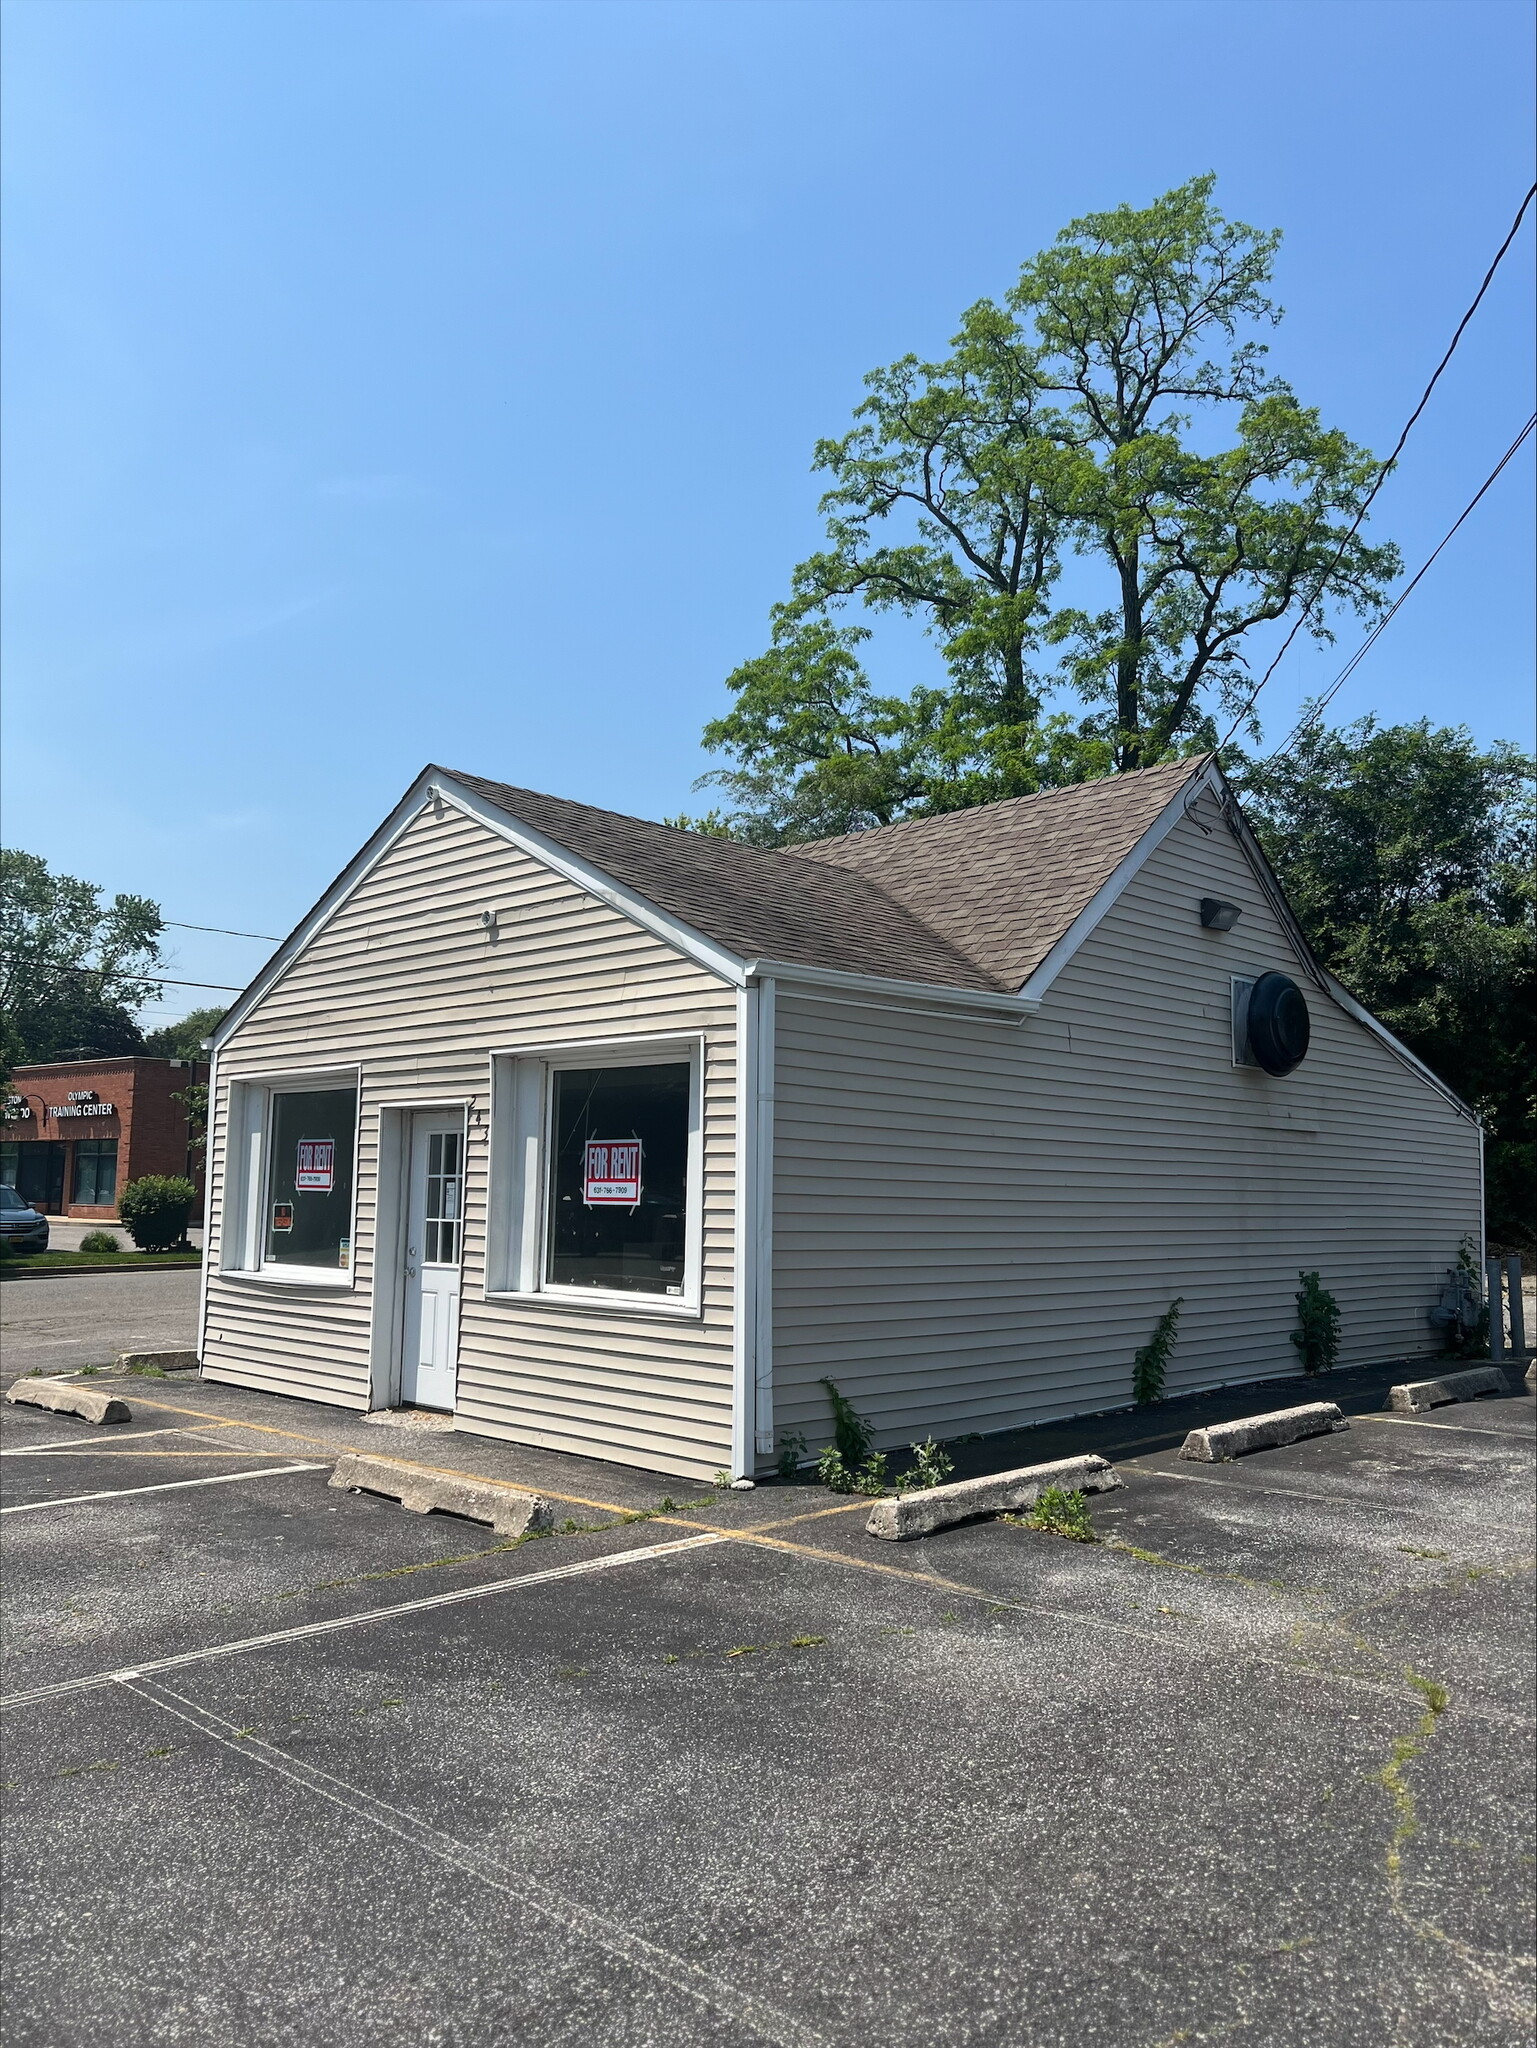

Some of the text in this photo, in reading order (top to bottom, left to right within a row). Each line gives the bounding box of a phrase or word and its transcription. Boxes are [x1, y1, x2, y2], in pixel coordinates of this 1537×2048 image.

[68, 1091, 93, 1101] OLYMPIC
[49, 1103, 113, 1117] TRAINING CENTER
[300, 1145, 332, 1170] FOR RENT
[588, 1146, 639, 1180] FOR RENT
